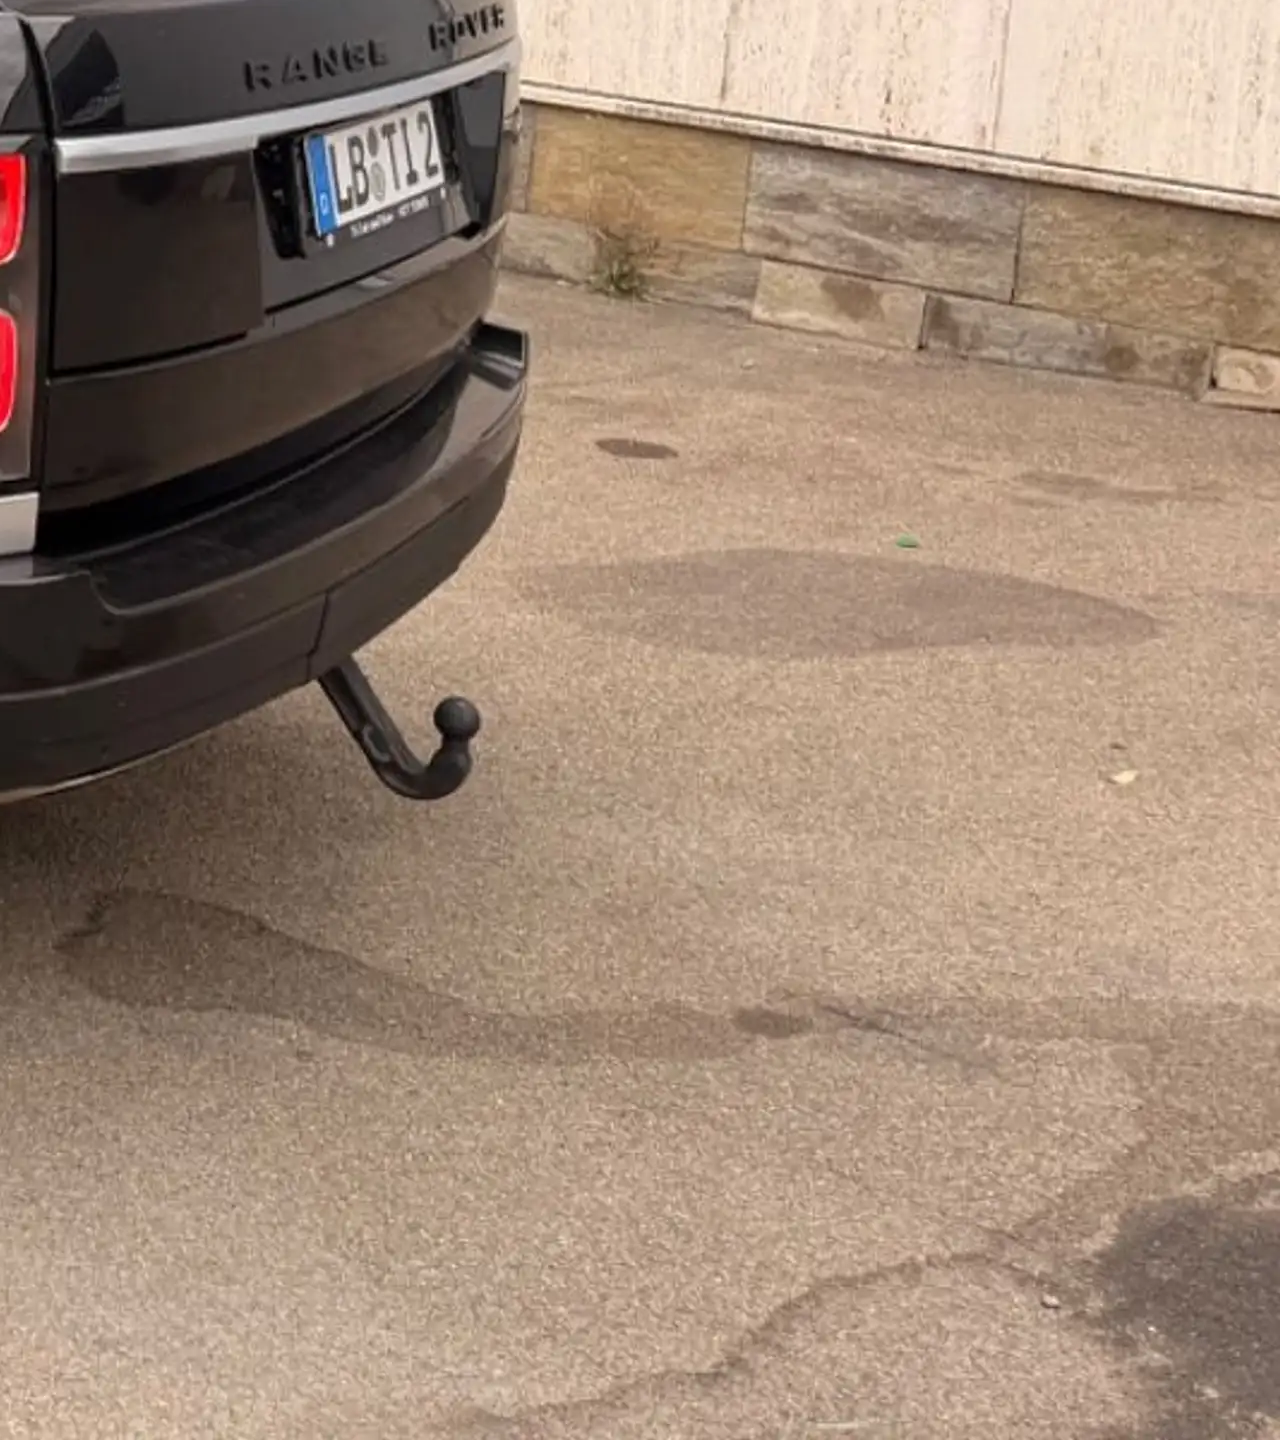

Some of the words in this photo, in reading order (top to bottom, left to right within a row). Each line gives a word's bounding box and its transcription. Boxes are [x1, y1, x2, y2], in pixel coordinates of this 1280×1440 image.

[243, 39, 388, 93] RANGE
[328, 134, 370, 213] LB
[380, 116, 419, 191] TI
[417, 110, 439, 179] 2
